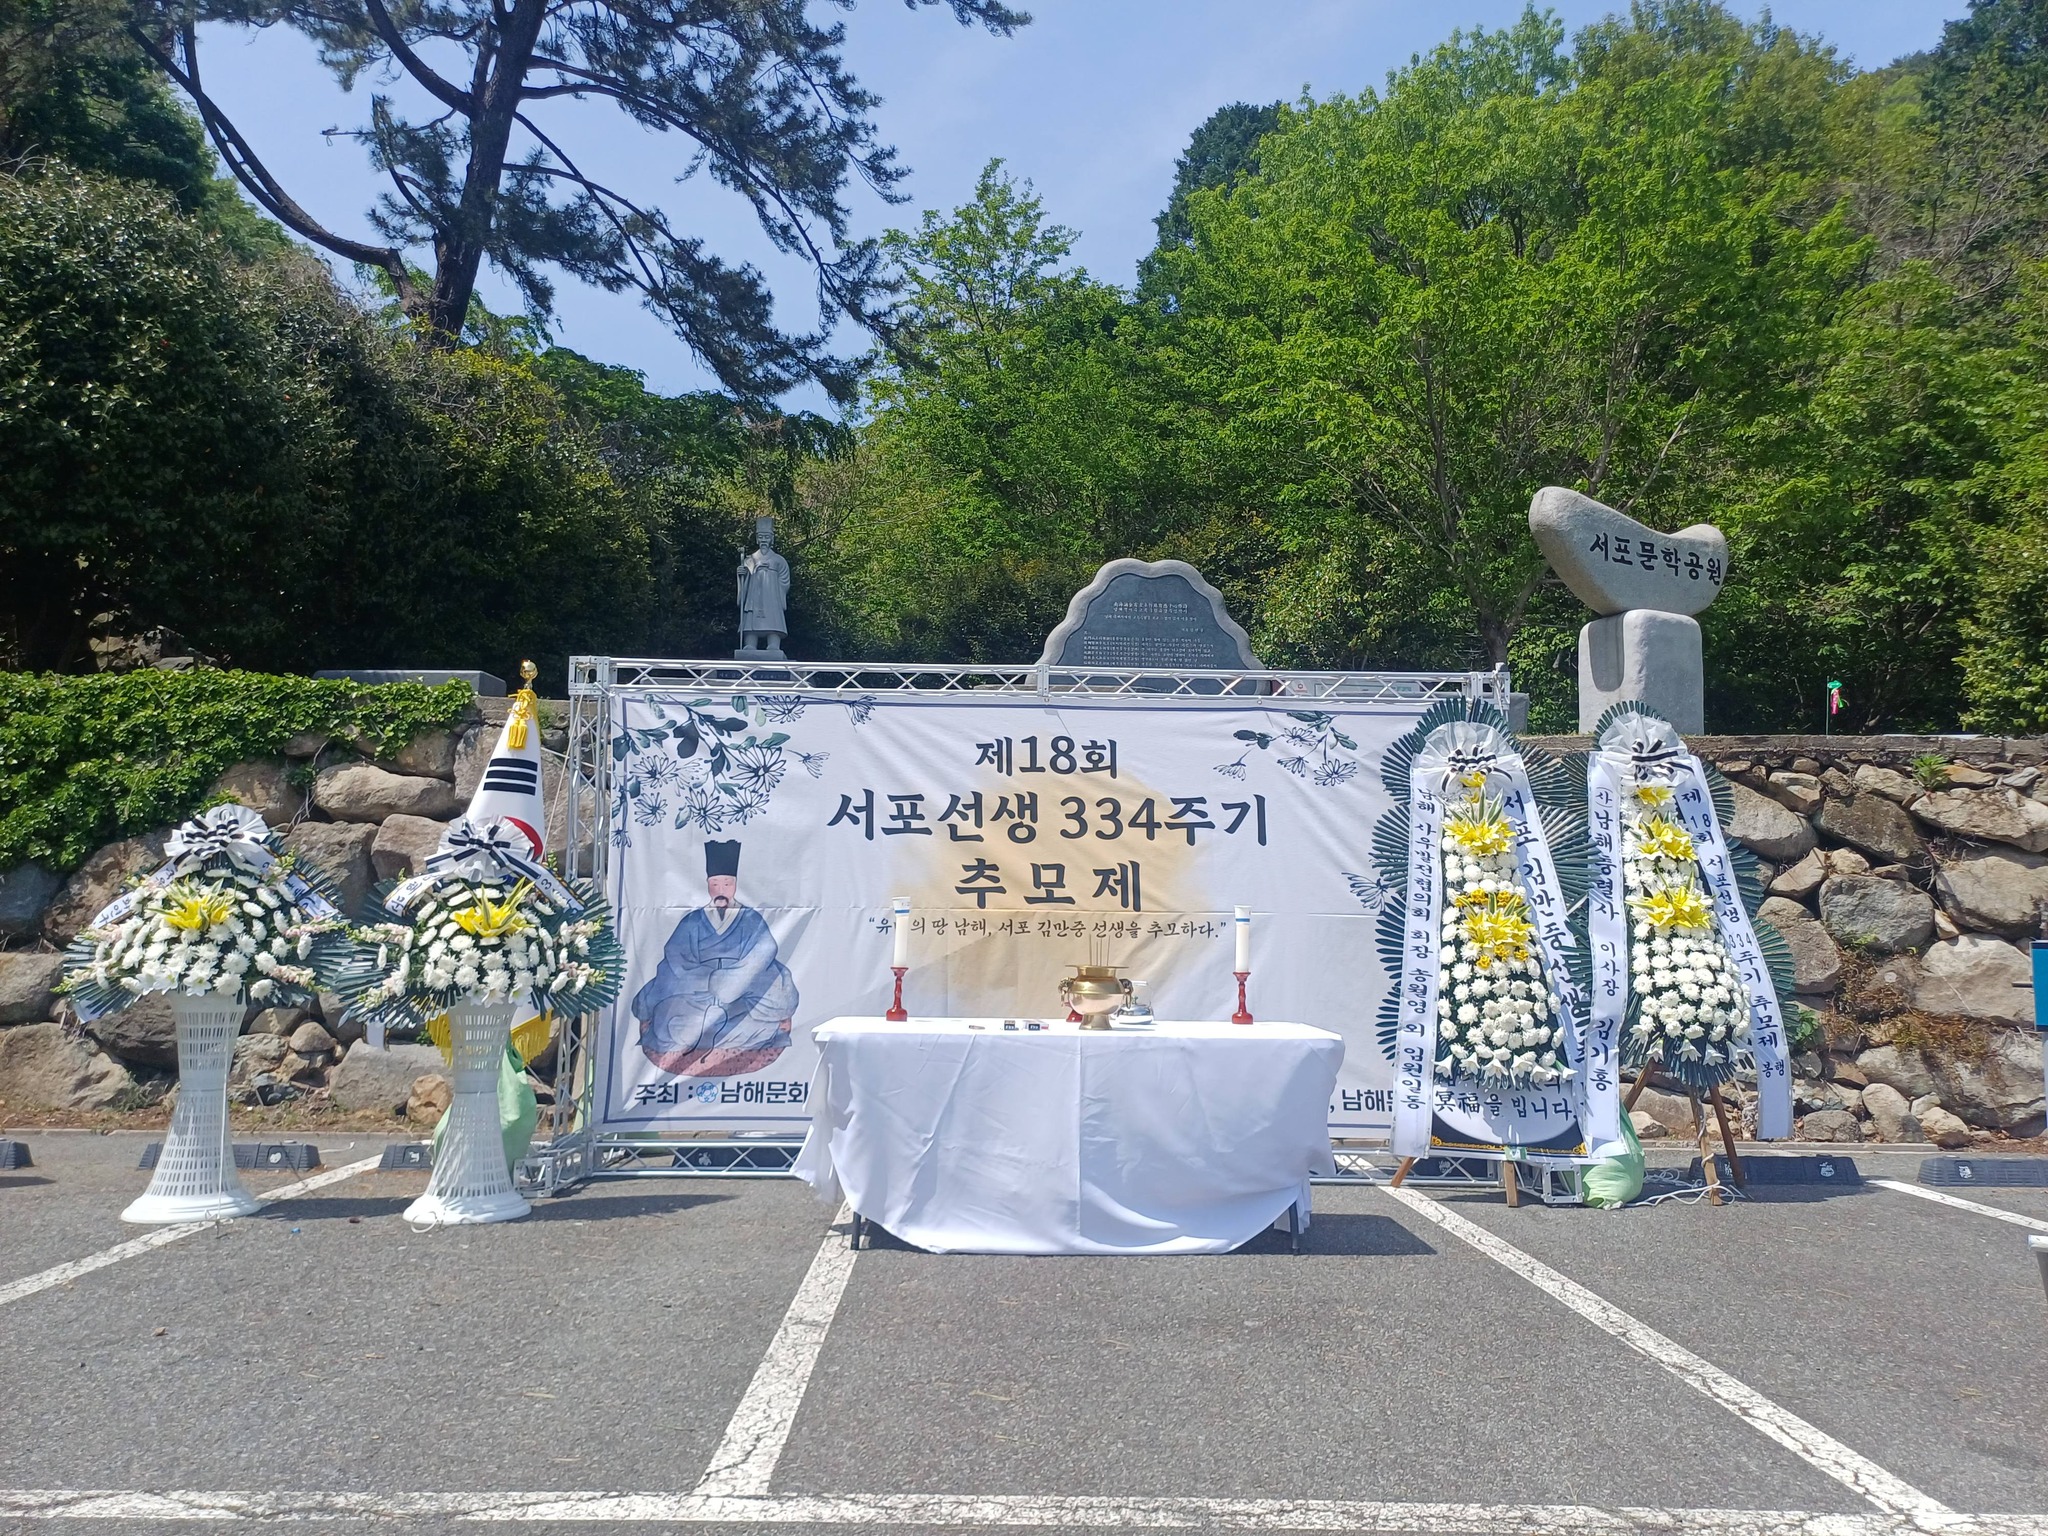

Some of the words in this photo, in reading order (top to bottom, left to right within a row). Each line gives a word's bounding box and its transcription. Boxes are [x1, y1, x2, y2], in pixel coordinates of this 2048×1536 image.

[1590, 532, 1721, 586] 서포문학공원
[975, 736, 1118, 779] 제18회
[827, 788, 1039, 844] 서포선생
[1059, 794, 1268, 846] 334주기
[1416, 787, 1436, 814] 남해
[1504, 790, 1539, 847] 서포
[1706, 855, 1740, 923] 서포선생
[932, 917, 948, 935] 땅
[955, 918, 991, 937] 남해,
[999, 919, 1031, 936] 서포
[1038, 920, 1086, 937] 김만중
[1092, 920, 1141, 938] 선생을
[1410, 930, 1433, 959] 회장
[1601, 942, 1620, 997] 이사장
[1404, 1023, 1424, 1037] 외
[1751, 995, 1779, 1049] 추모제
[1400, 1047, 1425, 1109] 임원일동
[1590, 1018, 1614, 1092] 김기홍
[1762, 1059, 1785, 1079] 봉행
[635, 1082, 678, 1105] 주최
[1434, 1091, 1502, 1117] 冥福을
